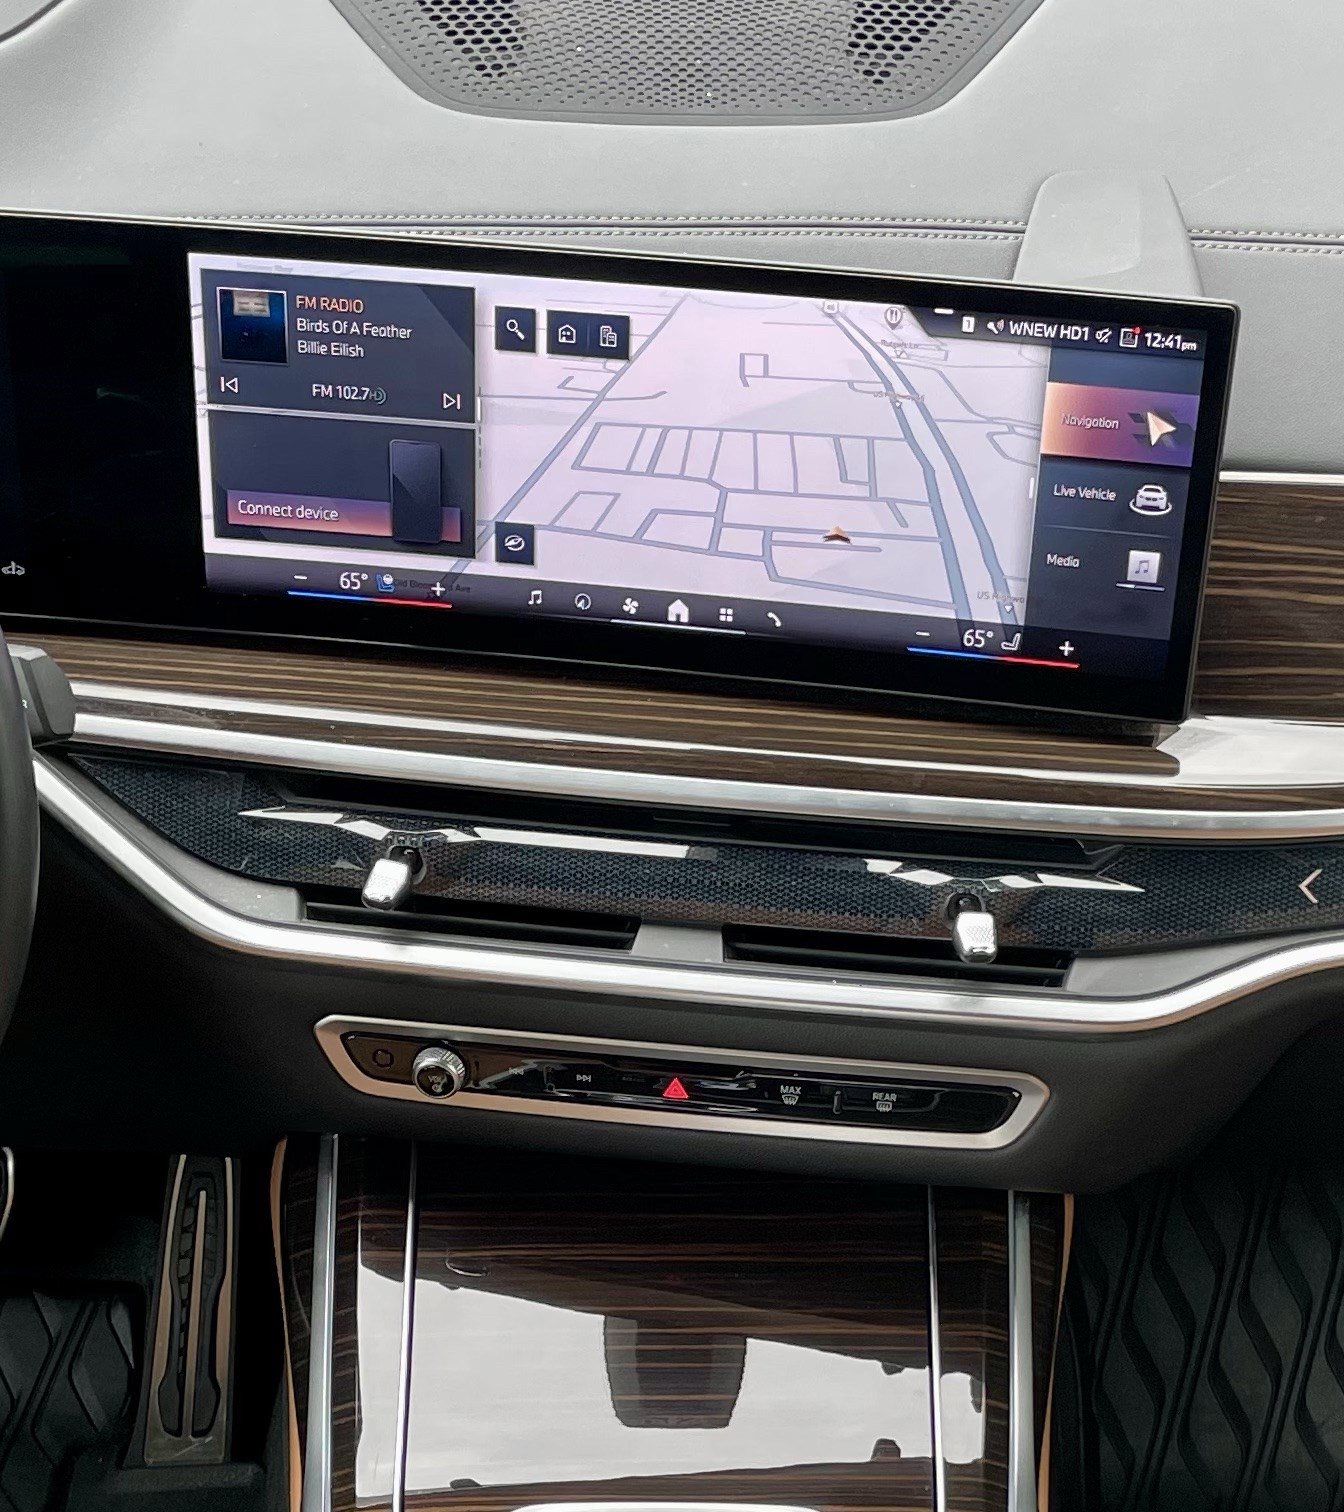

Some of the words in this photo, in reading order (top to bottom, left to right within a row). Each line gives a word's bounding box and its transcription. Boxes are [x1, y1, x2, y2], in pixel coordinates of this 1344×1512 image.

[296, 295, 317, 311] FM
[320, 297, 364, 314] RADIO
[296, 318, 329, 334] Birds
[333, 320, 348, 335] Of
[350, 321, 361, 335] A
[363, 323, 413, 340] Feather
[1009, 320, 1057, 339] WNEW
[1060, 325, 1090, 341] HD1
[297, 340, 328, 356] Billie
[330, 342, 365, 358] Eilish
[312, 384, 333, 399] FM
[336, 385, 370, 401] 102.7
[1061, 413, 1120, 430] Navigation
[1053, 484, 1076, 499] Live
[1079, 486, 1117, 502] Vehicle
[238, 500, 293, 518] Connect
[296, 503, 340, 521] device
[1046, 553, 1080, 568] Media
[339, 572, 369, 590] 65°
[963, 629, 994, 649] 65°
[780, 1084, 802, 1095] MAX
[872, 1092, 898, 1102] REAR
